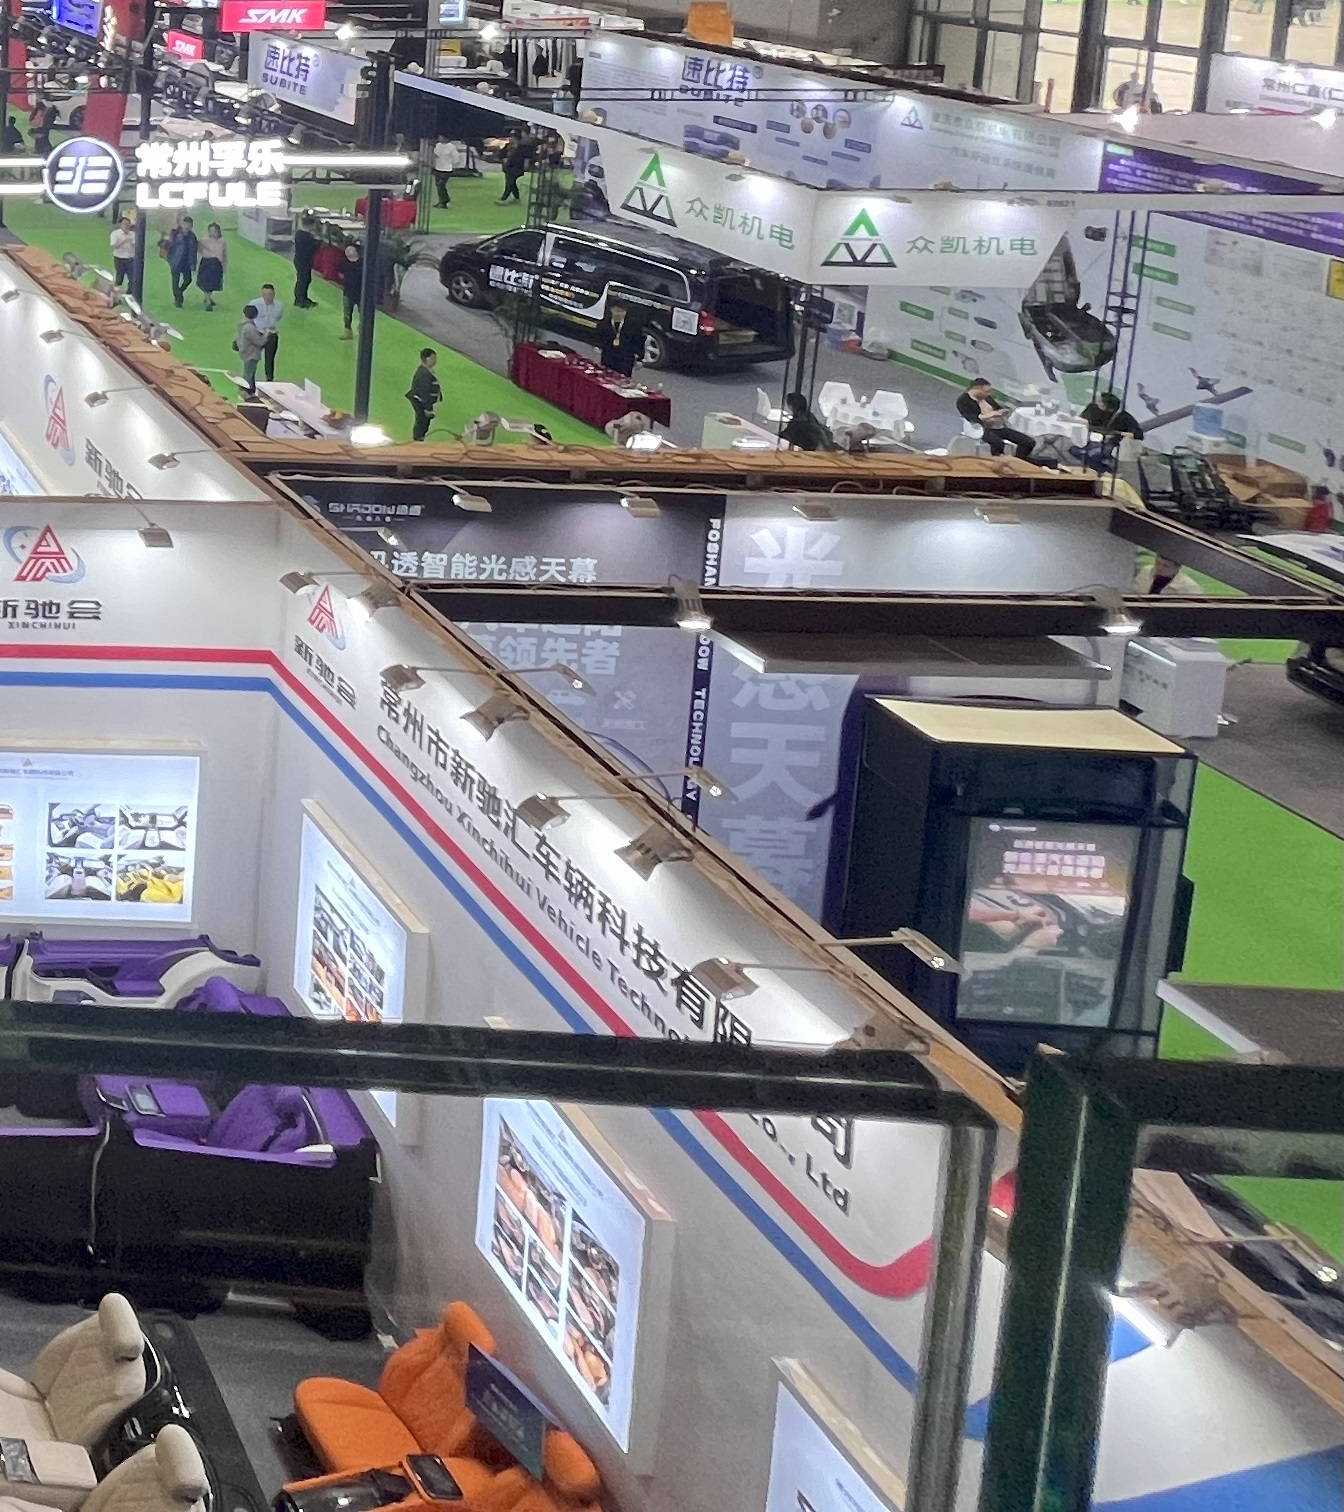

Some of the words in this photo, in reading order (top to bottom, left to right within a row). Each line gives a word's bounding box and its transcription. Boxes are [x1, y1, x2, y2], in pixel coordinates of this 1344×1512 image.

[238, 7, 309, 25] SMK
[263, 44, 311, 82] 速比特
[681, 55, 751, 94] 速比特
[261, 71, 308, 96] SUBITE
[684, 196, 795, 251] 众凯机电
[905, 235, 1039, 257] 众凯机电
[703, 517, 722, 587] FOSHAN
[7, 621, 77, 630] XINCHIHUI
[684, 687, 707, 801] TECHNOLGY
[376, 724, 454, 816] Changzhou
[456, 805, 533, 893] Xinchihui
[534, 886, 603, 971] Vehicle
[805, 1151, 851, 1217] Ltd
